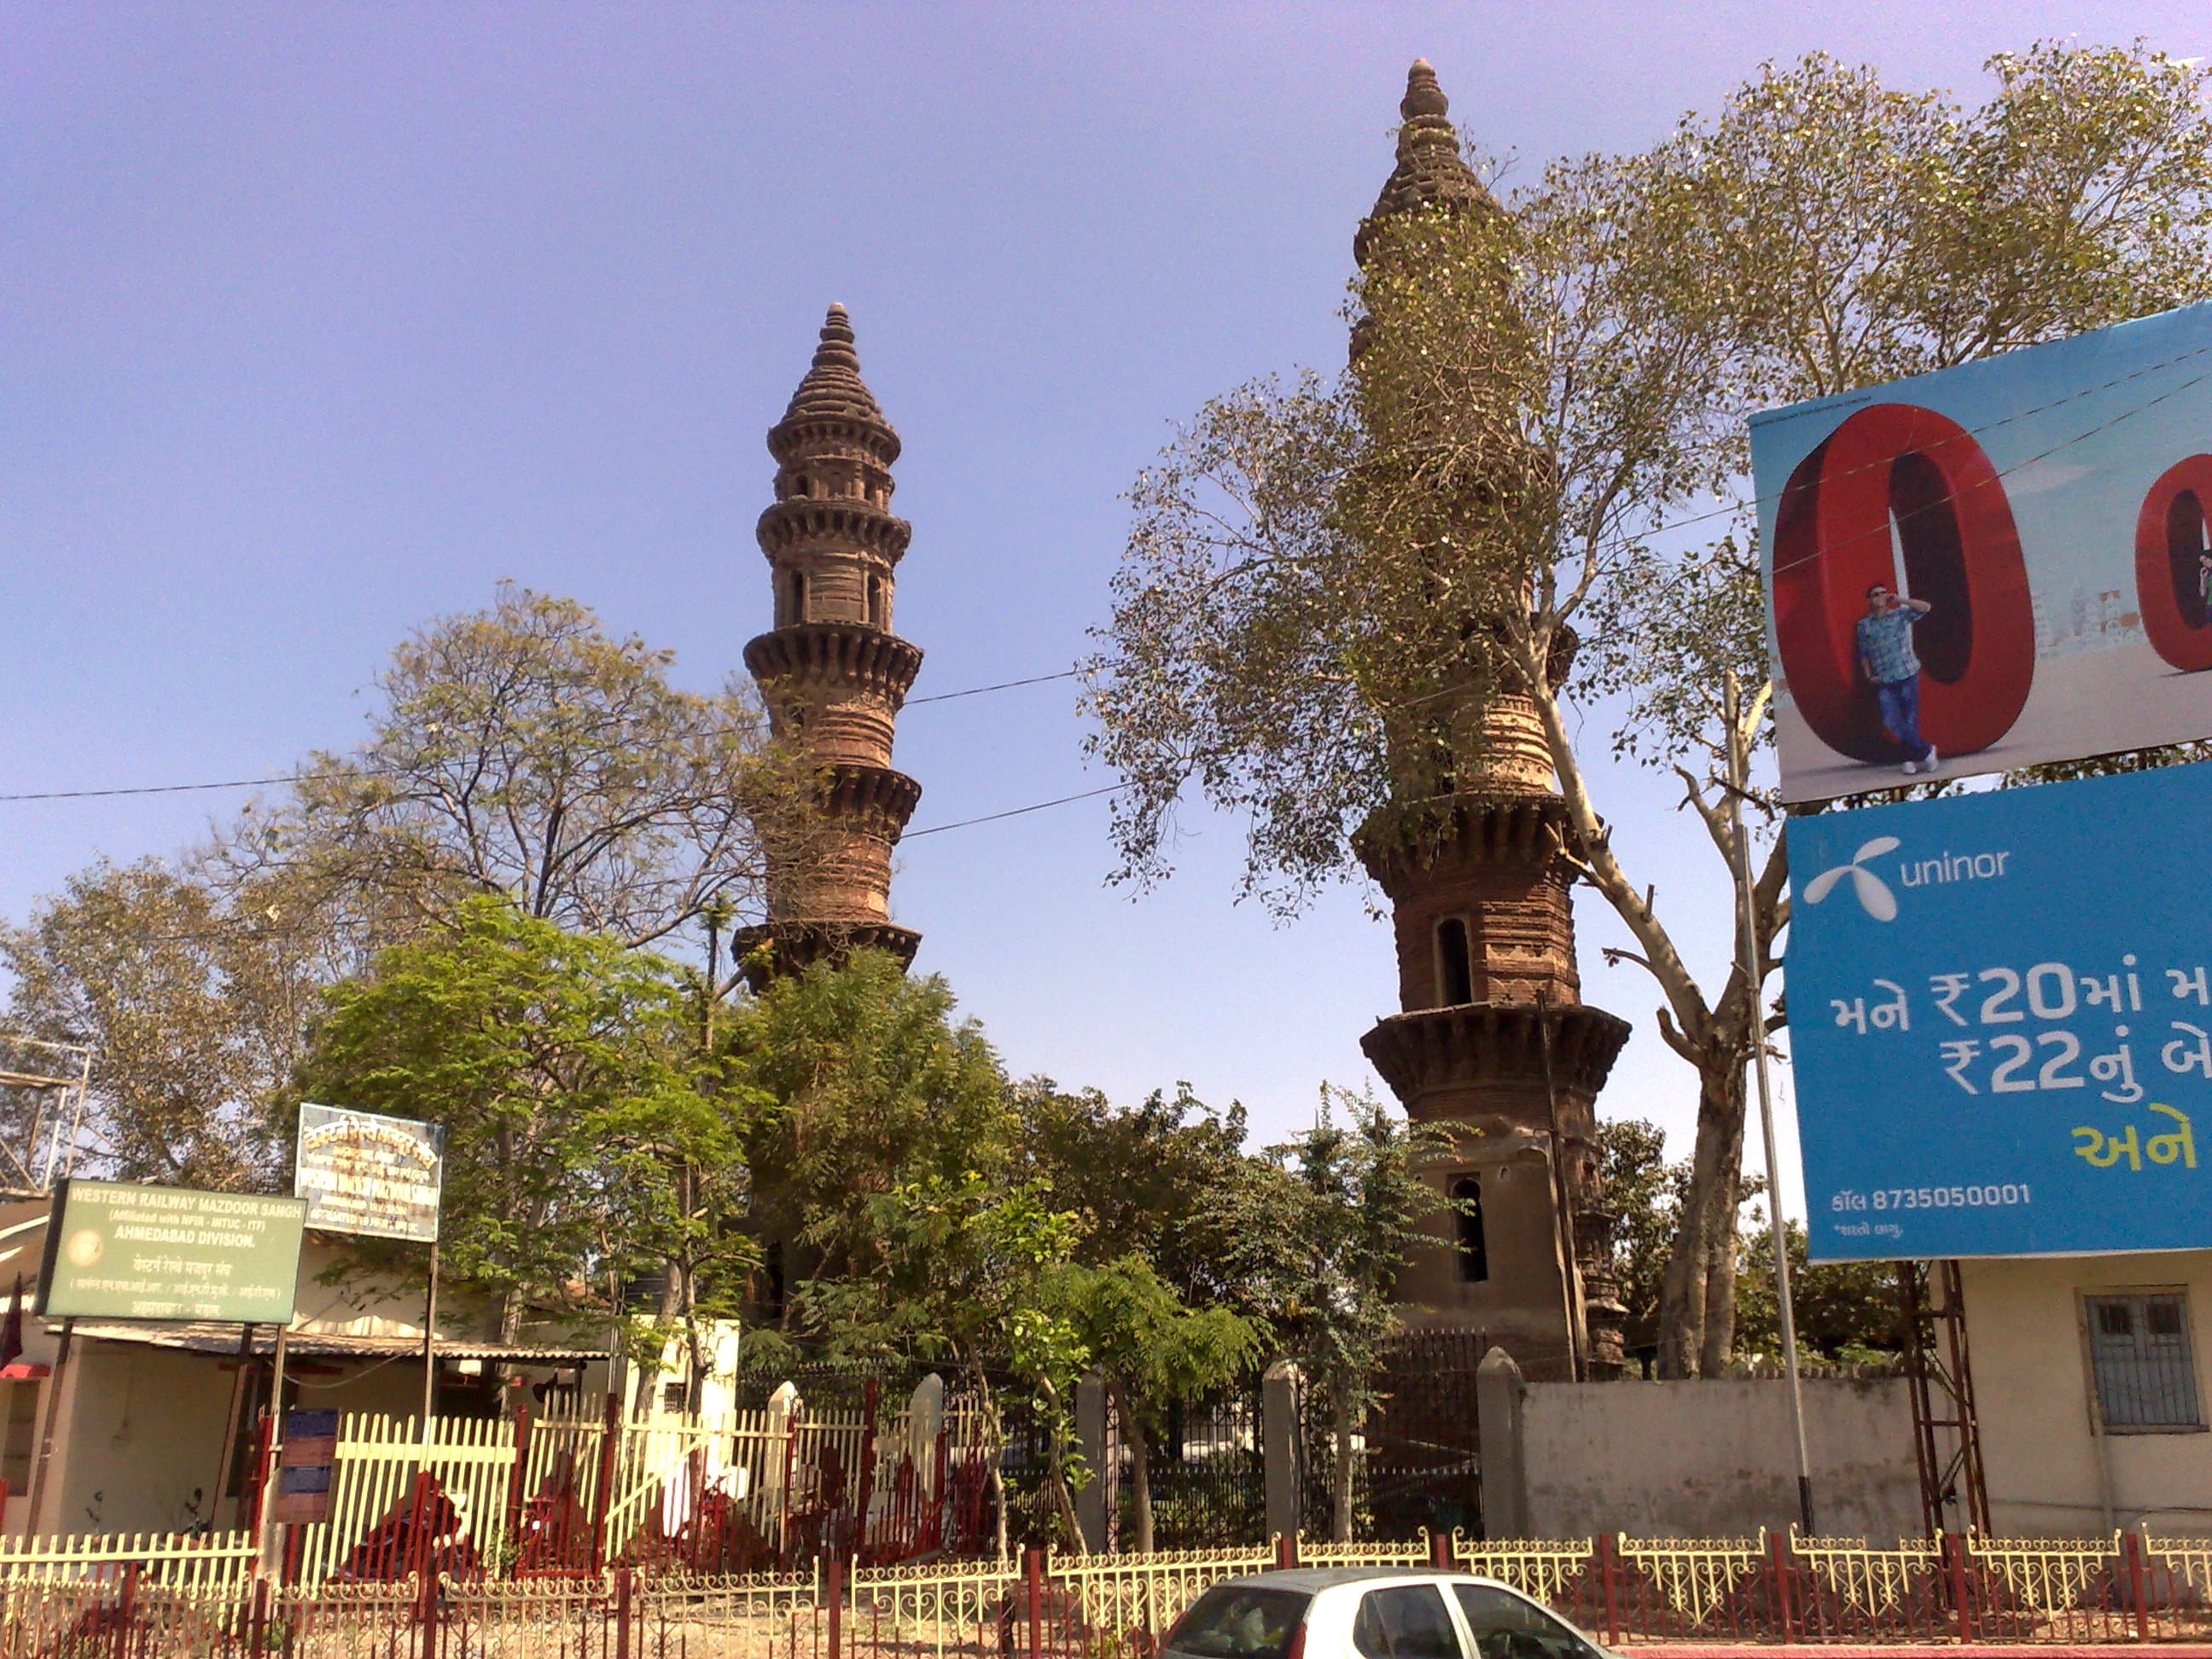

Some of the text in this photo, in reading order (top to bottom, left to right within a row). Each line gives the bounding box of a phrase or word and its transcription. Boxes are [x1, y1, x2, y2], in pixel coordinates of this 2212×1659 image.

[1901, 851, 2010, 888] uninor
[1830, 978, 1910, 1035] મને
[2071, 1102, 2197, 1172] અને
[72, 1187, 137, 1207] WESTERN
[139, 1193, 195, 1212] RAILWAY
[198, 1196, 259, 1215] MAZDOOR
[260, 1202, 302, 1219] SANGH
[1831, 1183, 2032, 1212] કૉલ 8735050001
[114, 1225, 256, 1249] AHMEDABAD DIVISION.
[159, 1213, 179, 1225] with
[181, 1214, 205, 1226] NFIR
[212, 1217, 242, 1230] INTUC
